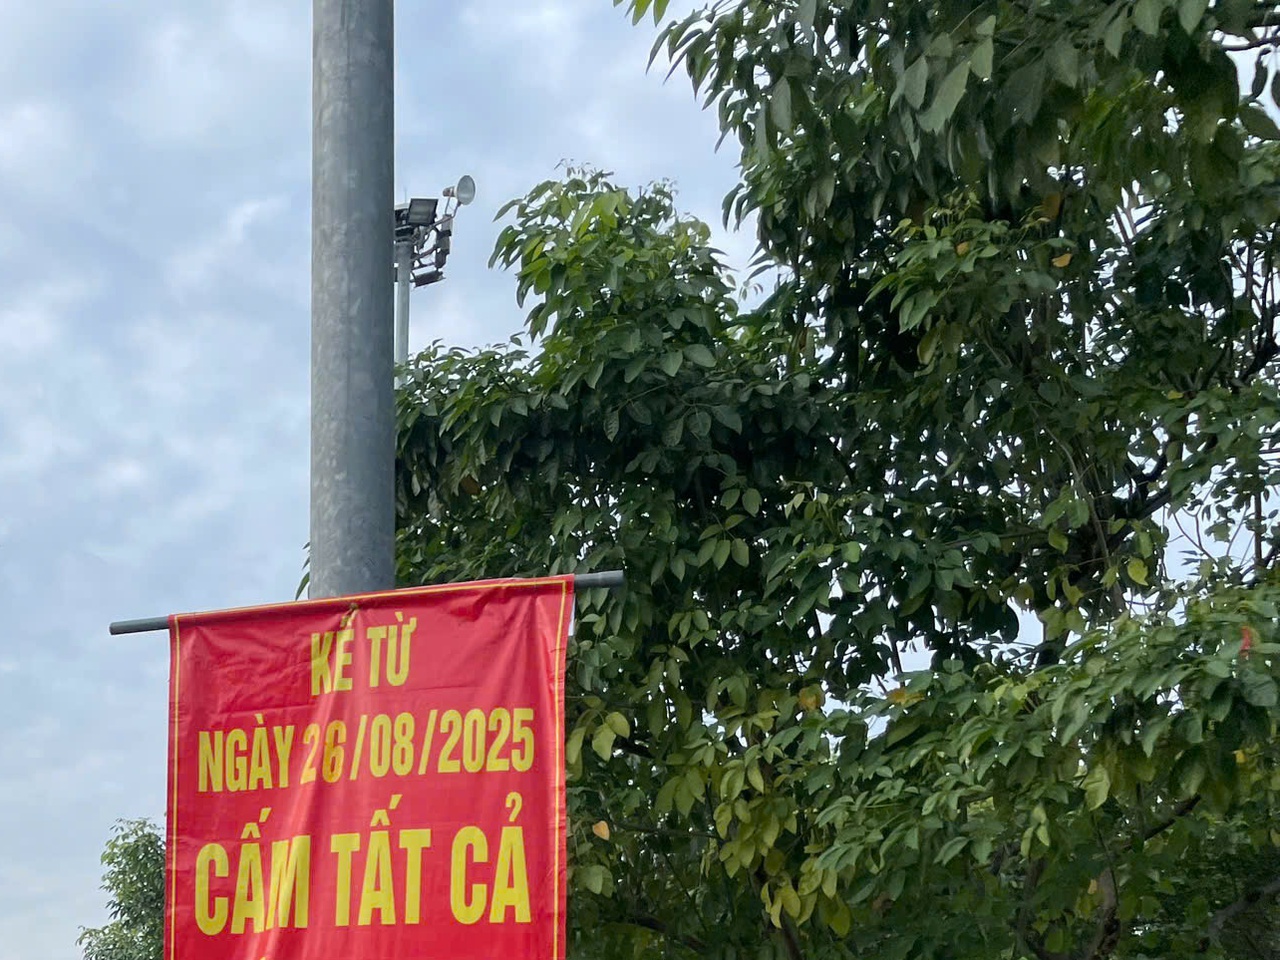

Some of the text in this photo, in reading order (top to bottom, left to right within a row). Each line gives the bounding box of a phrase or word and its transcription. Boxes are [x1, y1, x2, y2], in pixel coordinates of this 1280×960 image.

[366, 611, 417, 688] TỪ
[197, 707, 535, 793] NGÀY 26/08/2025
[194, 791, 532, 936] CẤM TẤT CẢ
